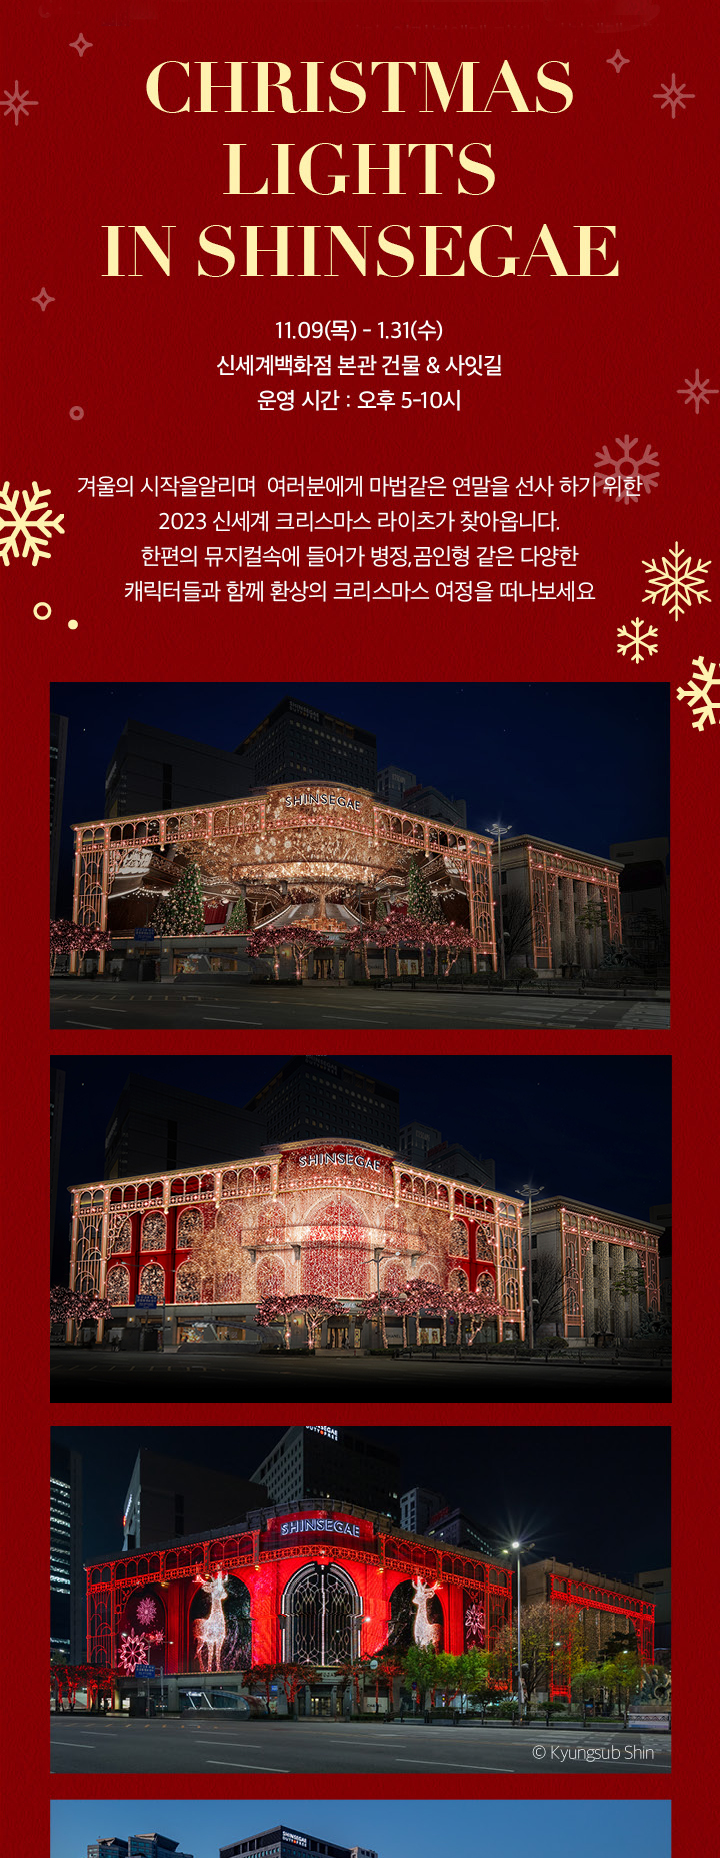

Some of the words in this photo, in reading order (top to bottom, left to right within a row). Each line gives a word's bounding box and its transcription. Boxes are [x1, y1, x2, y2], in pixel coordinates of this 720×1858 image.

[285, 793, 361, 812] SHINSEGAE
[298, 1152, 381, 1173] SHINSEGAE
[280, 1518, 361, 1538] SHINSEGAE
